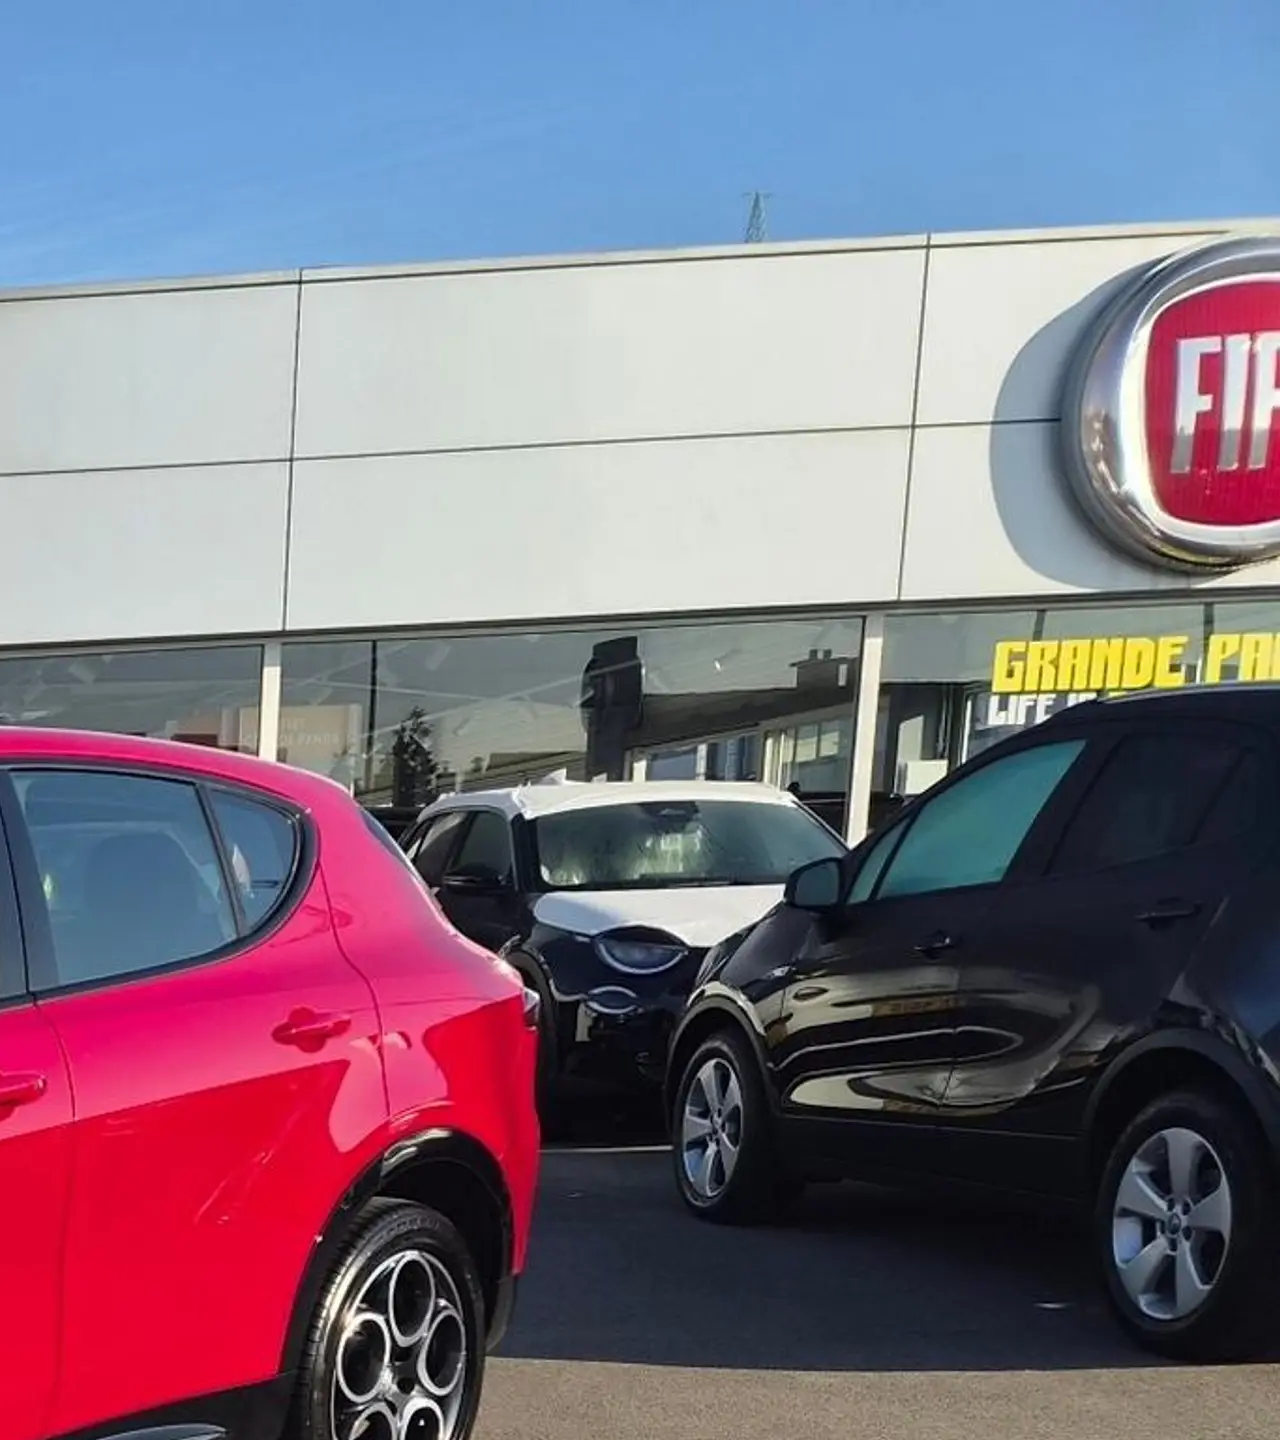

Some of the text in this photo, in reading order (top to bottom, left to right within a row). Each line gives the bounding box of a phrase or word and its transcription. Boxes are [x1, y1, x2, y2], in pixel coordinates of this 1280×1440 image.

[992, 633, 1280, 692] GRANDE PA
[988, 693, 1056, 724] LIFE
